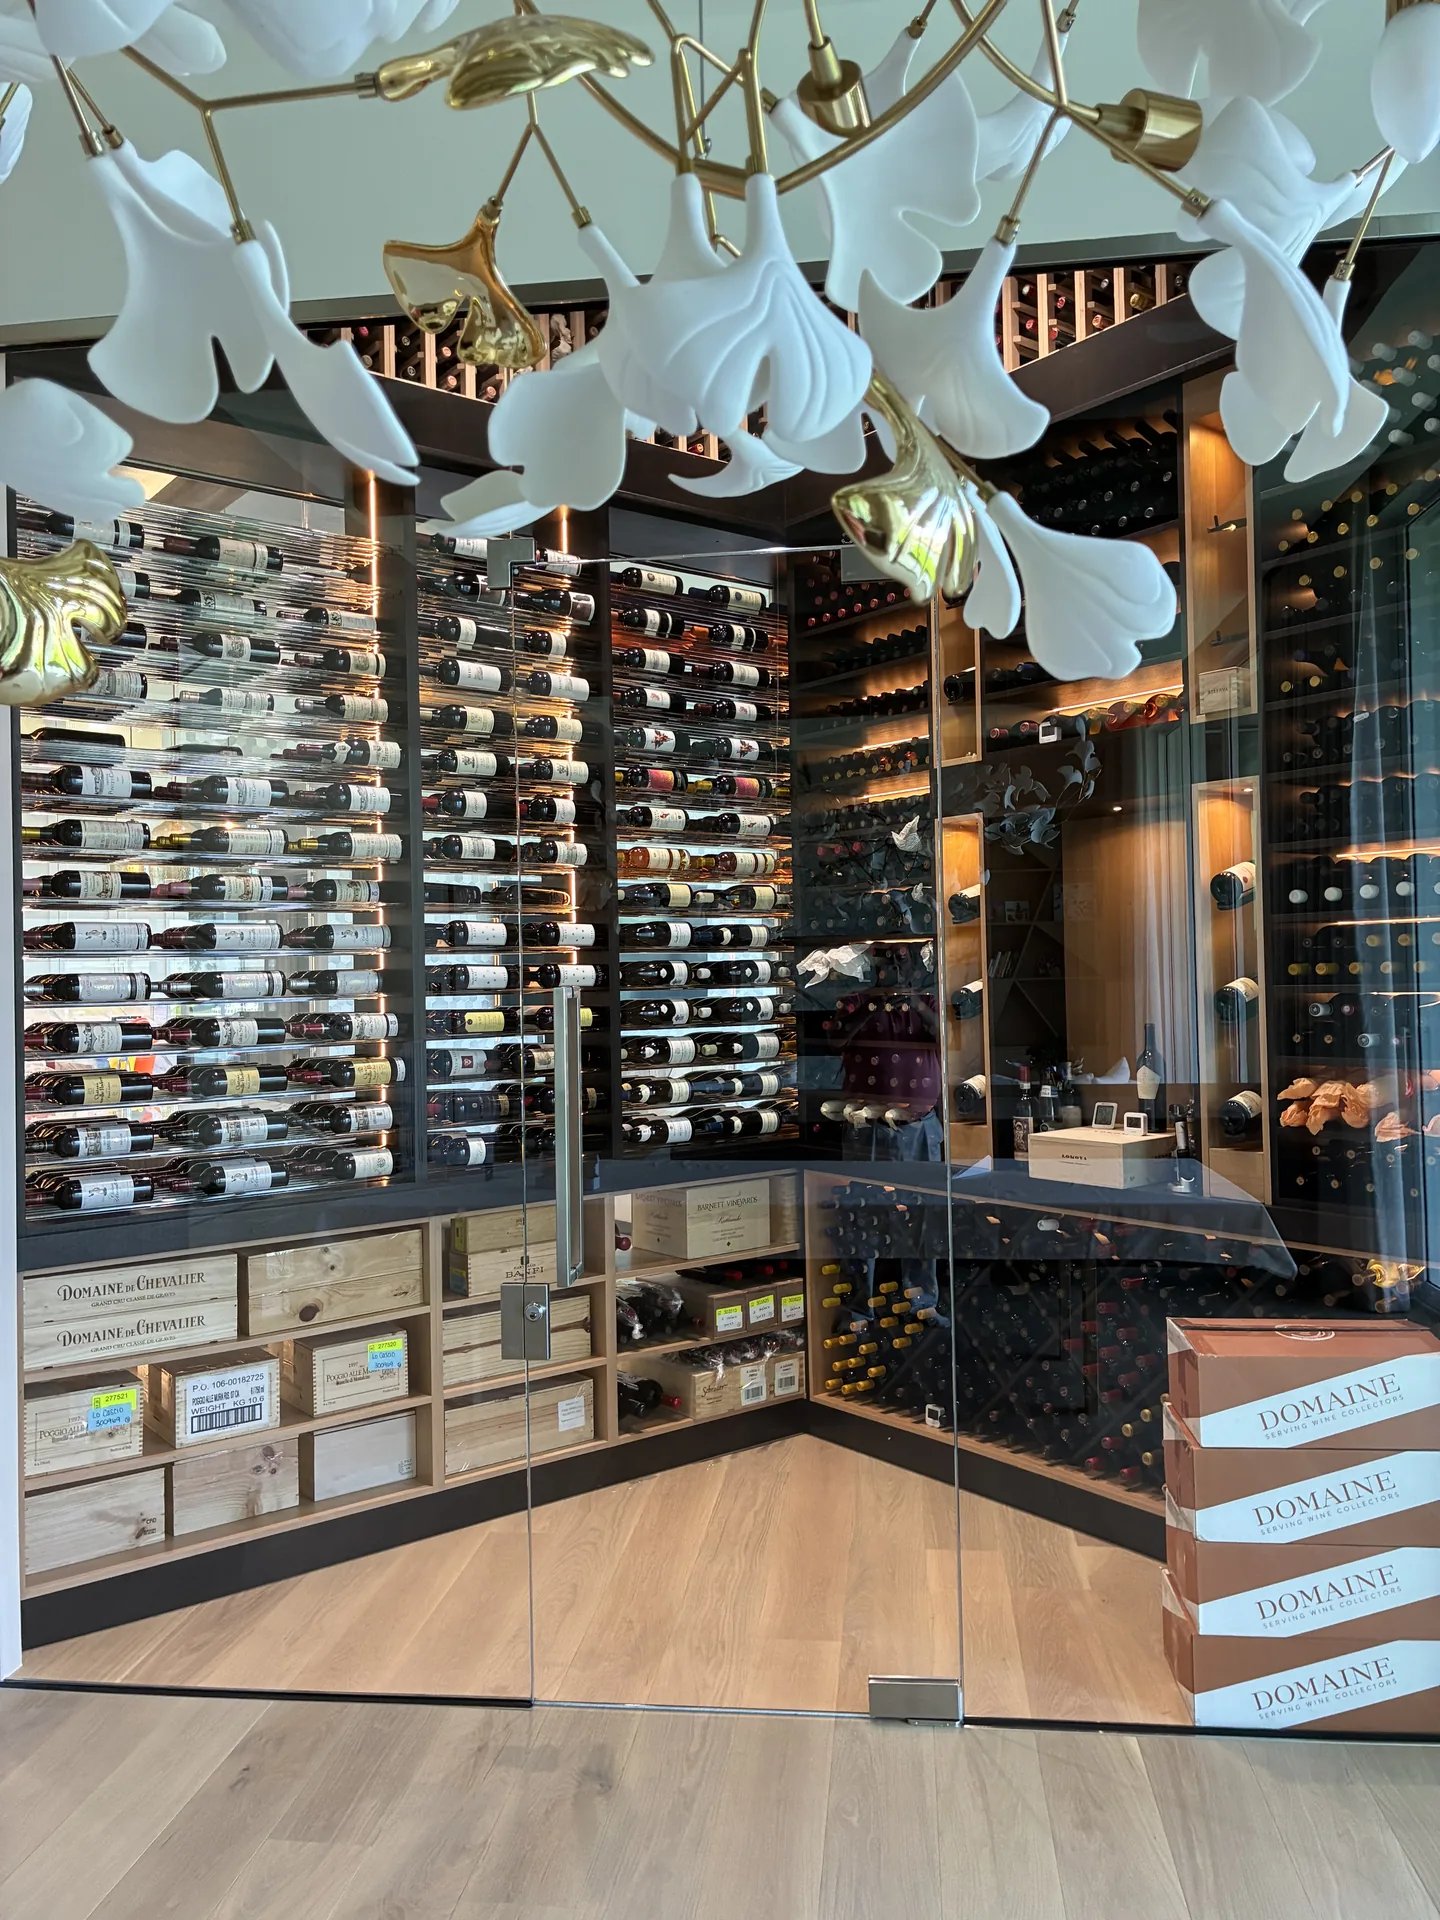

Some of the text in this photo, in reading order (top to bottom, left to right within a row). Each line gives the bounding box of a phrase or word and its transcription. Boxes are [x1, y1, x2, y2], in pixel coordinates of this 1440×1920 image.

[697, 1196, 758, 1212] BARNETT VINEYARDS
[91, 1300, 113, 1308] GRAND
[91, 1345, 113, 1353] GRAND
[378, 1341, 397, 1349] 277520
[192, 1373, 264, 1392] P.O. 106-00182725
[326, 1372, 349, 1382] POGGIO
[349, 1369, 362, 1377] ALLE
[105, 1393, 128, 1403] 277521
[191, 1396, 264, 1415] WEIGHT KG 10.6
[1257, 1373, 1401, 1431] DOMAINE
[1265, 1394, 1404, 1440] SERVING WINE COLLECTORS
[39, 1428, 68, 1440] POGGIO
[1252, 1470, 1396, 1527] DOMAINE
[1260, 1491, 1400, 1536] SERVING WINE COLLECTORS
[1255, 1564, 1399, 1620] DOMAINE
[1263, 1585, 1402, 1630] SERVING WINE COLLECTORS
[1251, 1657, 1394, 1711] DOMAINE
[1259, 1678, 1397, 1720] SERVING WINE COLLECTORS
